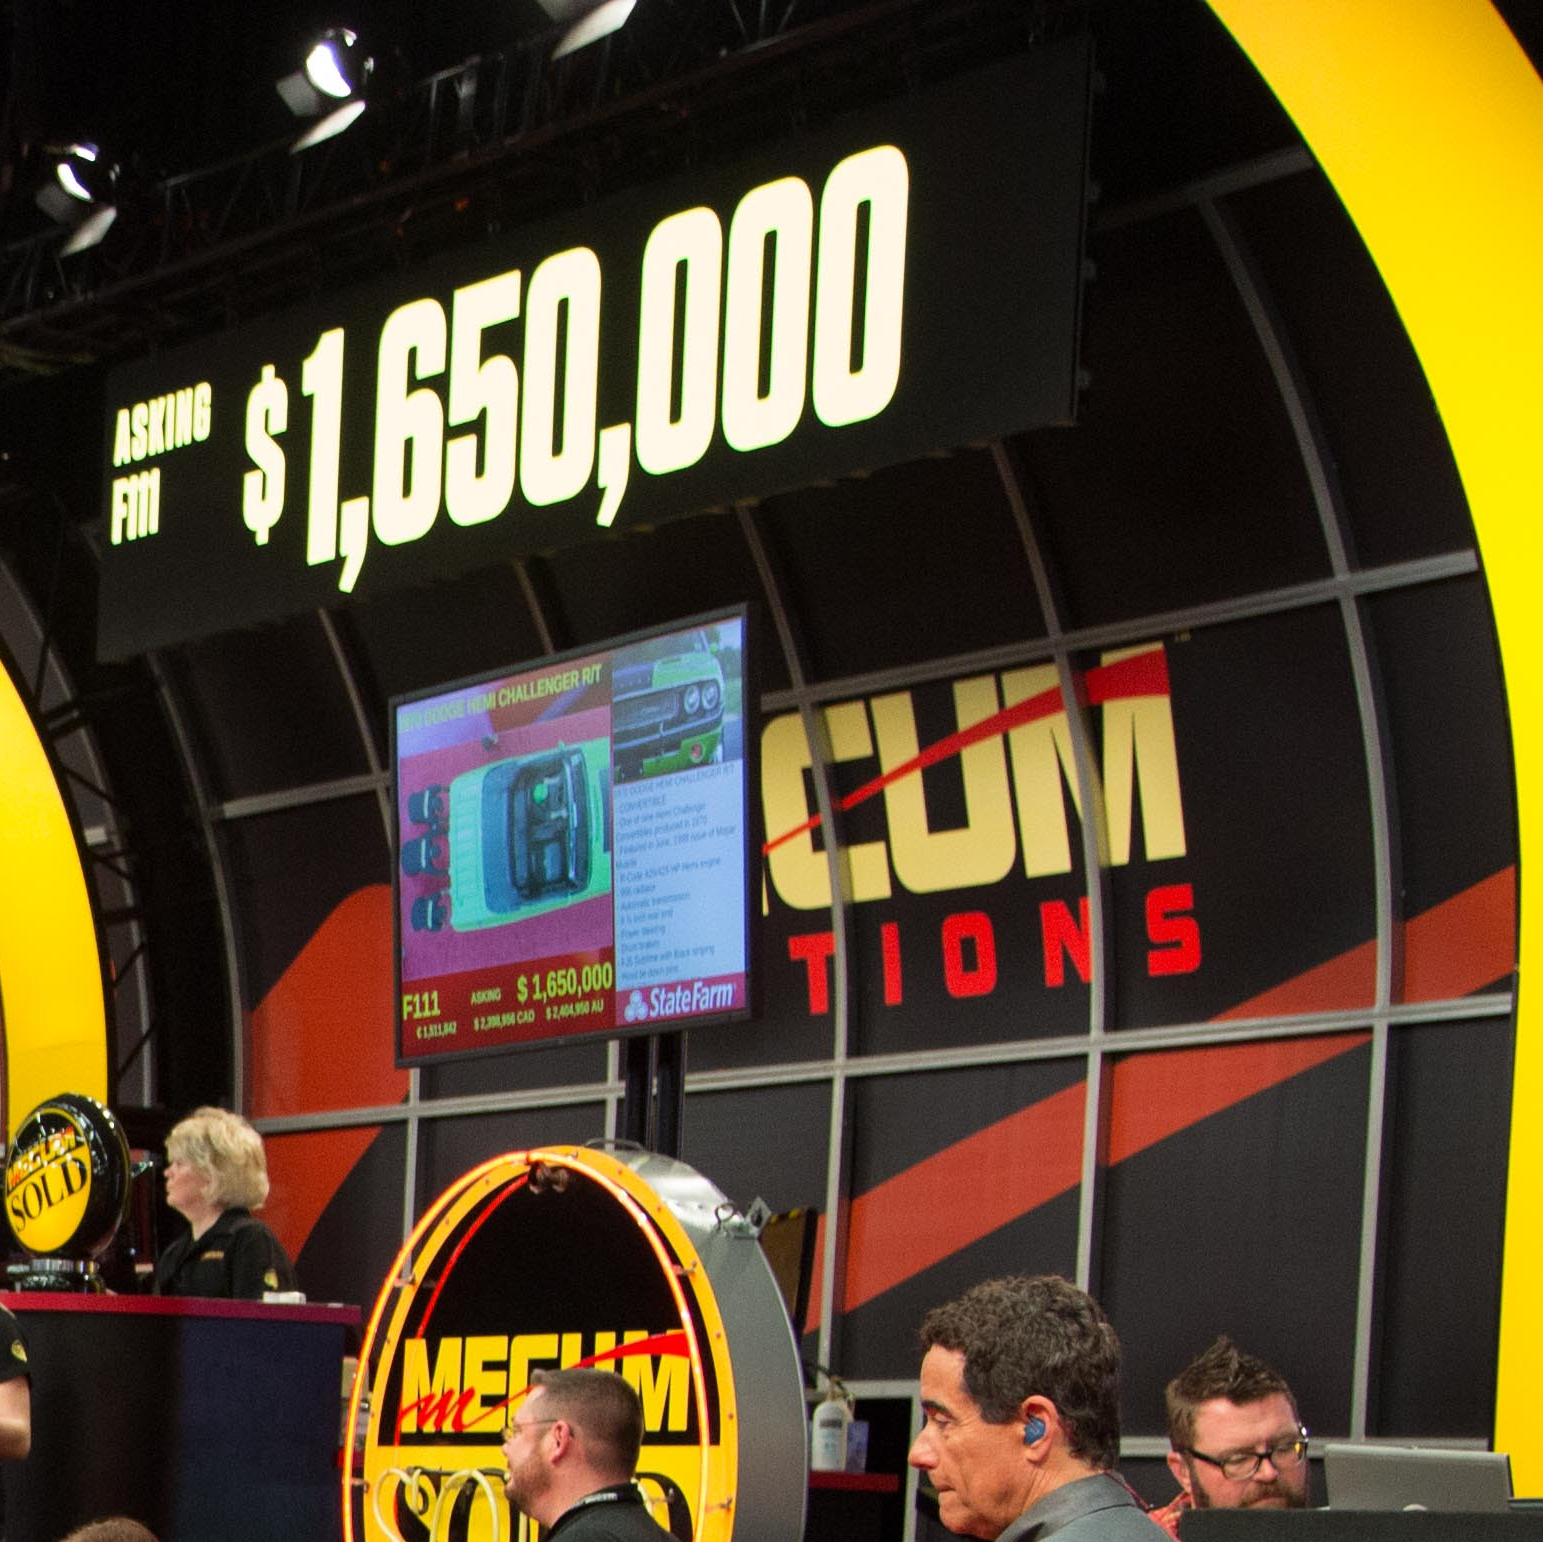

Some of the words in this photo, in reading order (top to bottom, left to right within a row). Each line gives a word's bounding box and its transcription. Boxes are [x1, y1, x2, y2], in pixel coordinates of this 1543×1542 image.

[113, 381, 212, 468] ASKING
[111, 467, 161, 546] F111
[467, 691, 497, 715] HEMI
[498, 669, 580, 708] CHALLENGER
[581, 663, 603, 686] R/T
[760, 642, 1186, 917] CUM
[402, 991, 441, 1021] F111
[11, 1155, 88, 1233] SOLD
